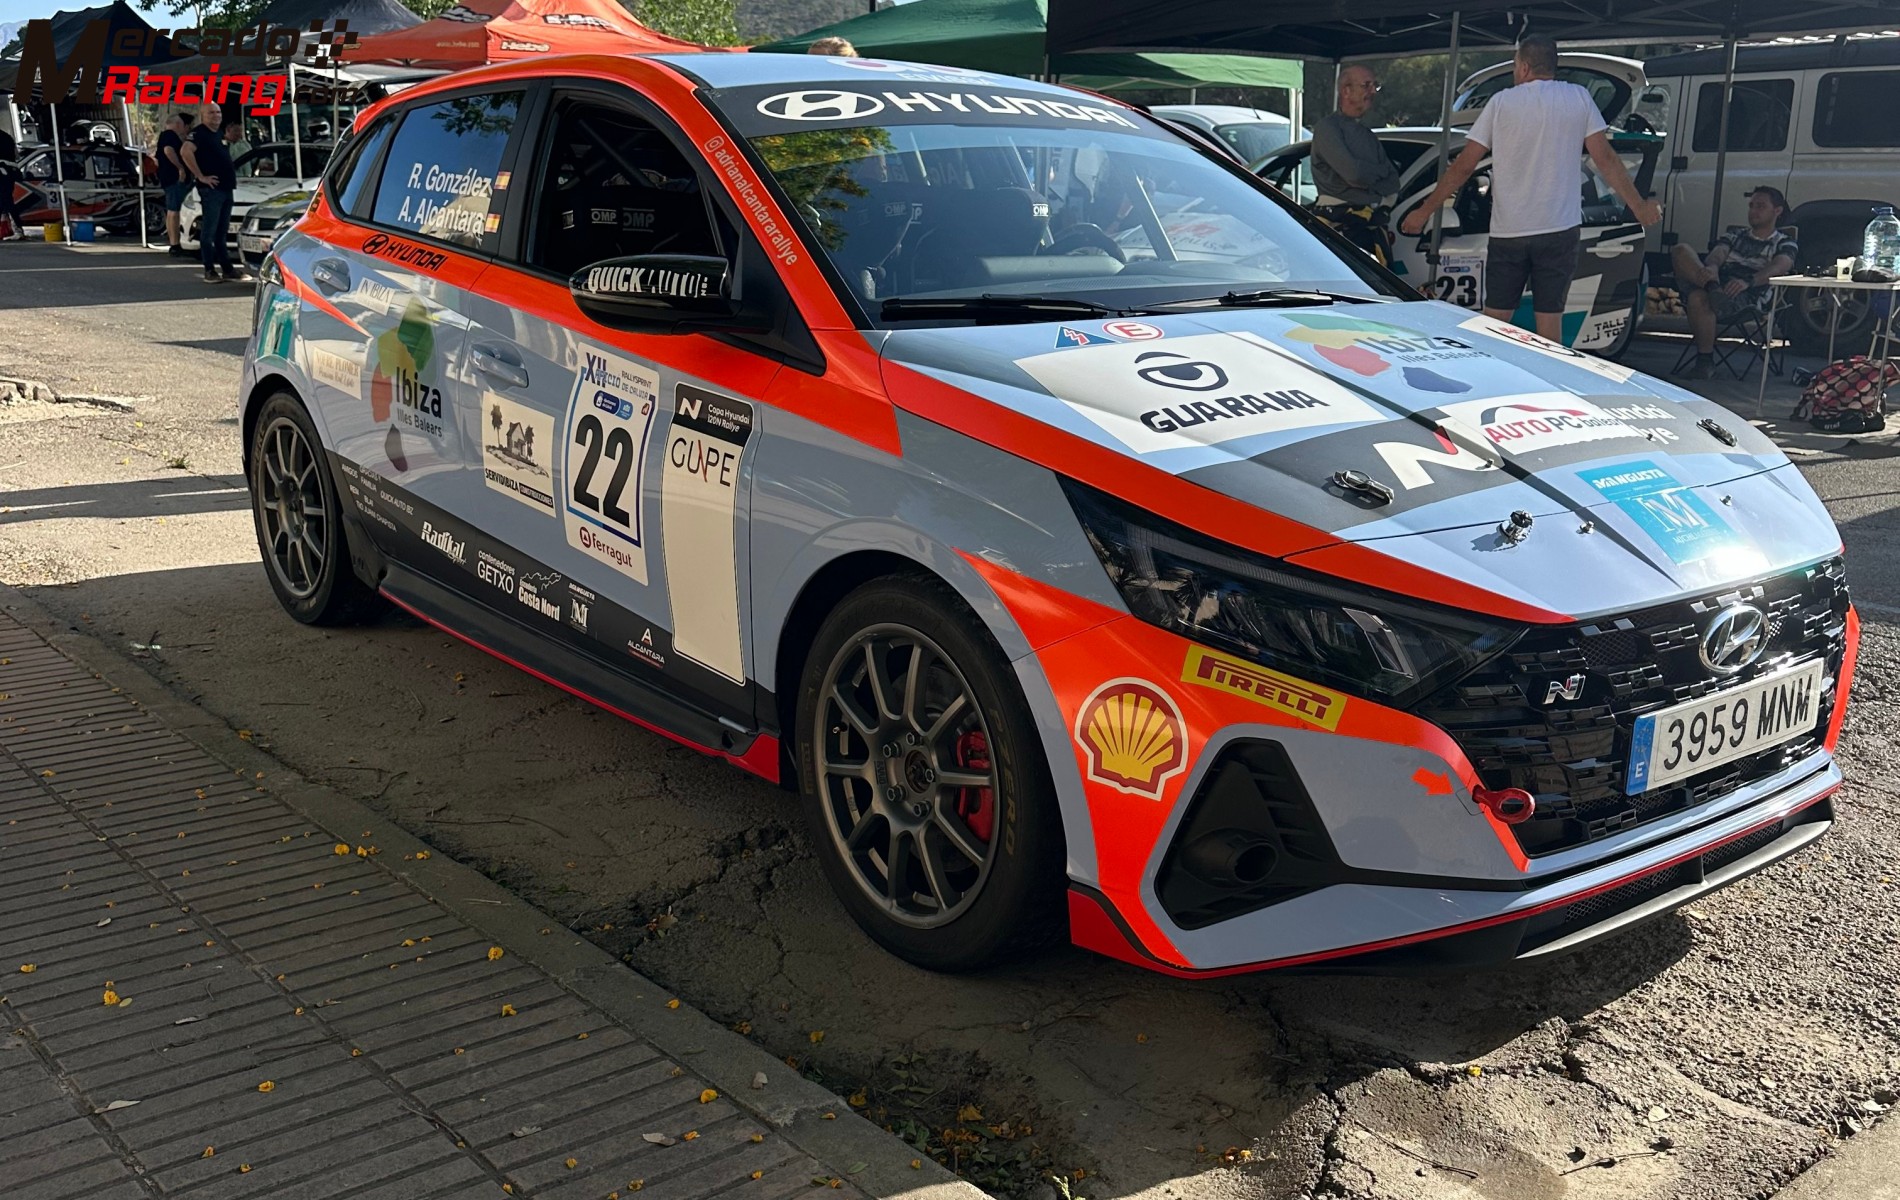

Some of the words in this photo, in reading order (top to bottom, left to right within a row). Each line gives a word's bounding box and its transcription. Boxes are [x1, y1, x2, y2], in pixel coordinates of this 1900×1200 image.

[882, 91, 1140, 130] HYUNDAI
[407, 162, 422, 189] R.
[425, 165, 493, 198] González
[397, 195, 412, 223] A.
[413, 198, 485, 235] Alcántara
[591, 211, 617, 222] OMP
[715, 148, 798, 266] adrianalcantararallye
[382, 241, 449, 272] HYUNDAI
[588, 266, 645, 294] QUICK
[1436, 275, 1477, 307] 23
[1113, 324, 1151, 339] E
[1353, 333, 1473, 355] Ibiza
[1397, 354, 1436, 363] Illes
[396, 366, 442, 419] Ibiza
[413, 414, 443, 438] Balears
[708, 403, 724, 417] Copa
[724, 410, 750, 425] Hyundai
[722, 418, 741, 433] Rallye
[1139, 389, 1331, 434] GUARANA
[1484, 419, 1553, 444] AUTO
[1543, 415, 1583, 431] PC
[574, 413, 634, 529] 22
[421, 520, 466, 560] Radikal
[592, 533, 633, 568] ferragut
[477, 560, 514, 594] GETXO
[478, 549, 516, 576] contenedores
[518, 586, 541, 611] Costa
[541, 597, 560, 622] Nord
[627, 639, 666, 664] ALCANTARA
[1197, 655, 1332, 720] PIRELLI
[1663, 697, 1749, 771] 3959
[1756, 673, 1814, 741] MNM
[1635, 760, 1645, 779] E
